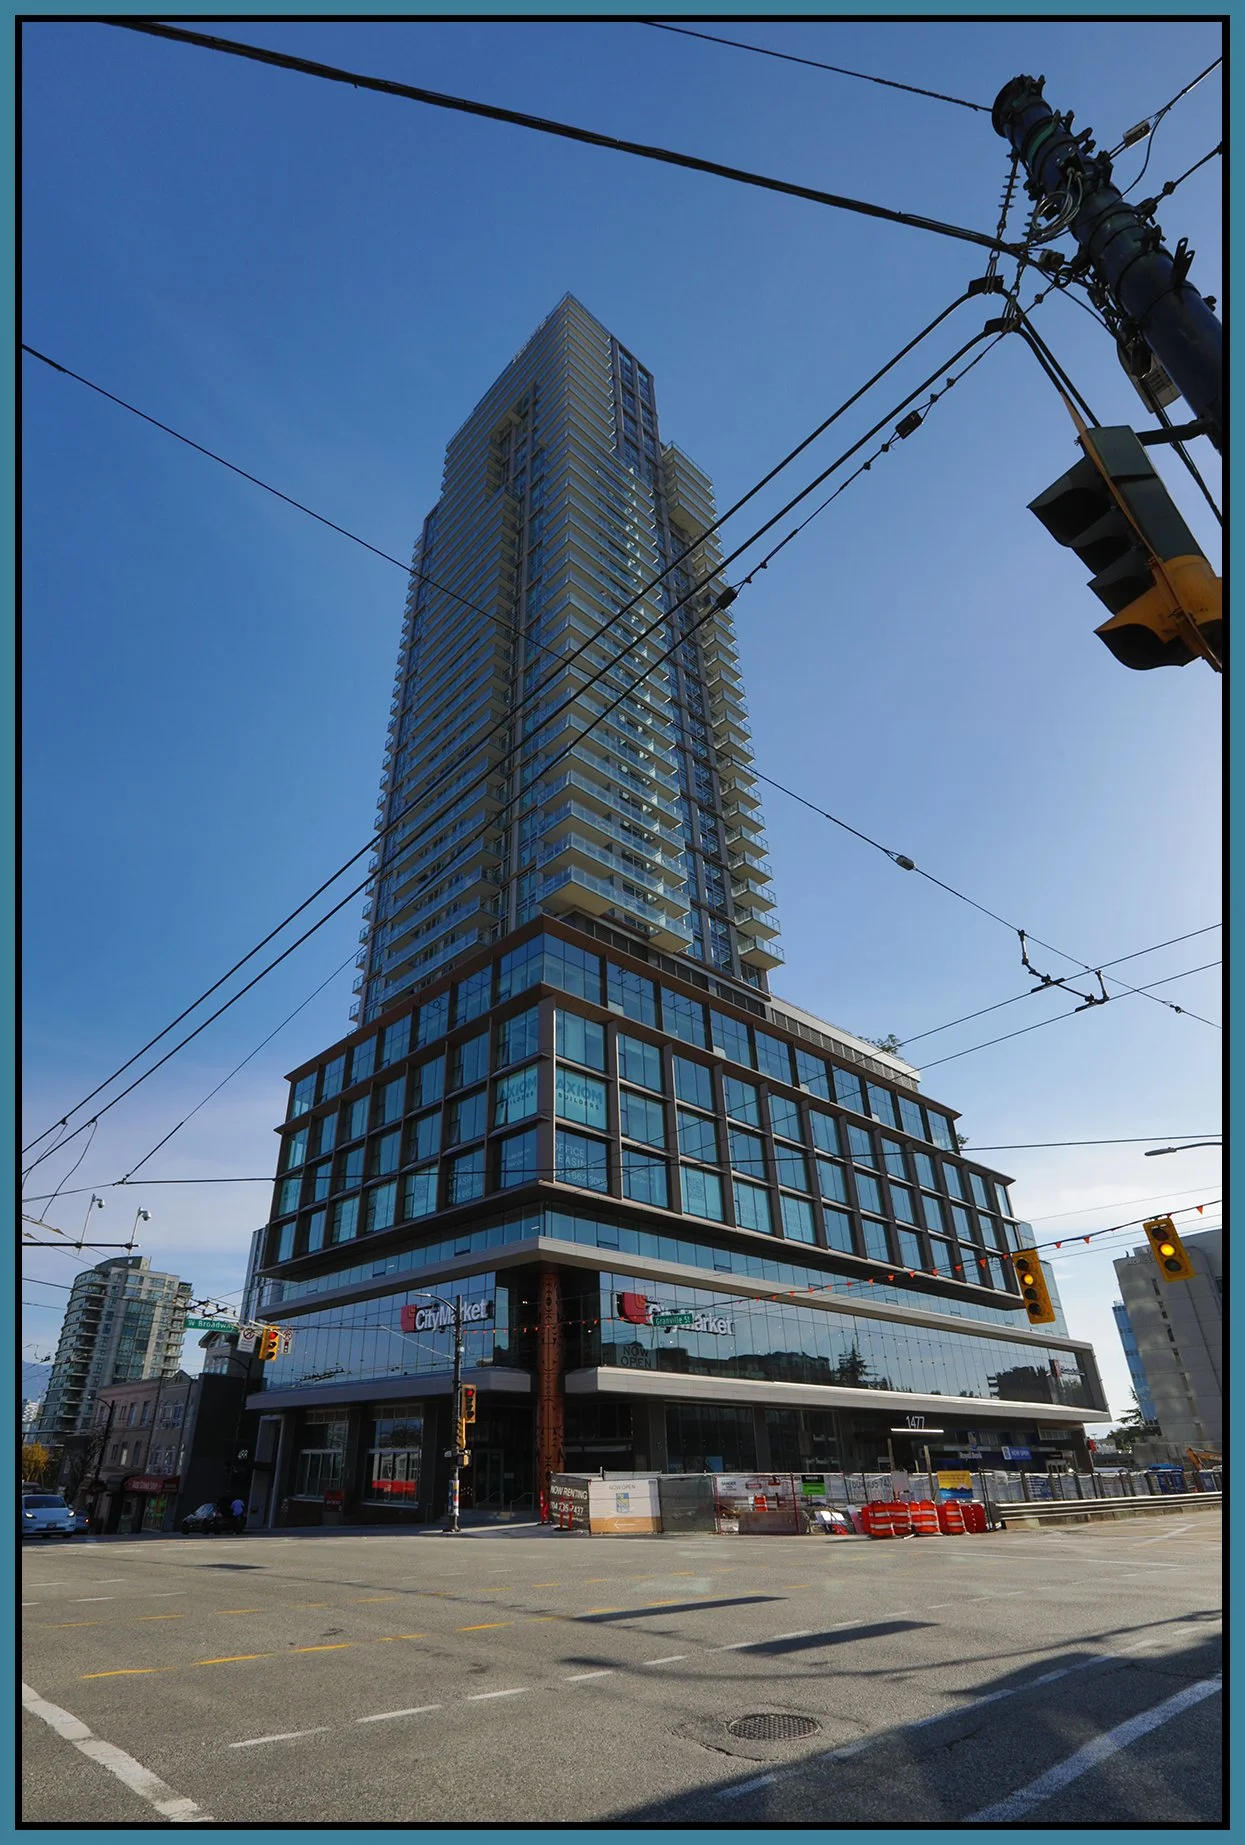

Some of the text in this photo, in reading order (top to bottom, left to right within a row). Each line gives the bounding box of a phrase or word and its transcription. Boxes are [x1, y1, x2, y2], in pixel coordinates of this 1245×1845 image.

[556, 1079, 603, 1104] AXIOM
[558, 1091, 600, 1111] BUILDERS
[655, 1314, 691, 1326] Granville St
[623, 1345, 648, 1357] NOW
[620, 1356, 652, 1368] OPEN
[905, 1415, 925, 1429] 1477
[563, 1487, 588, 1500] RENTING
